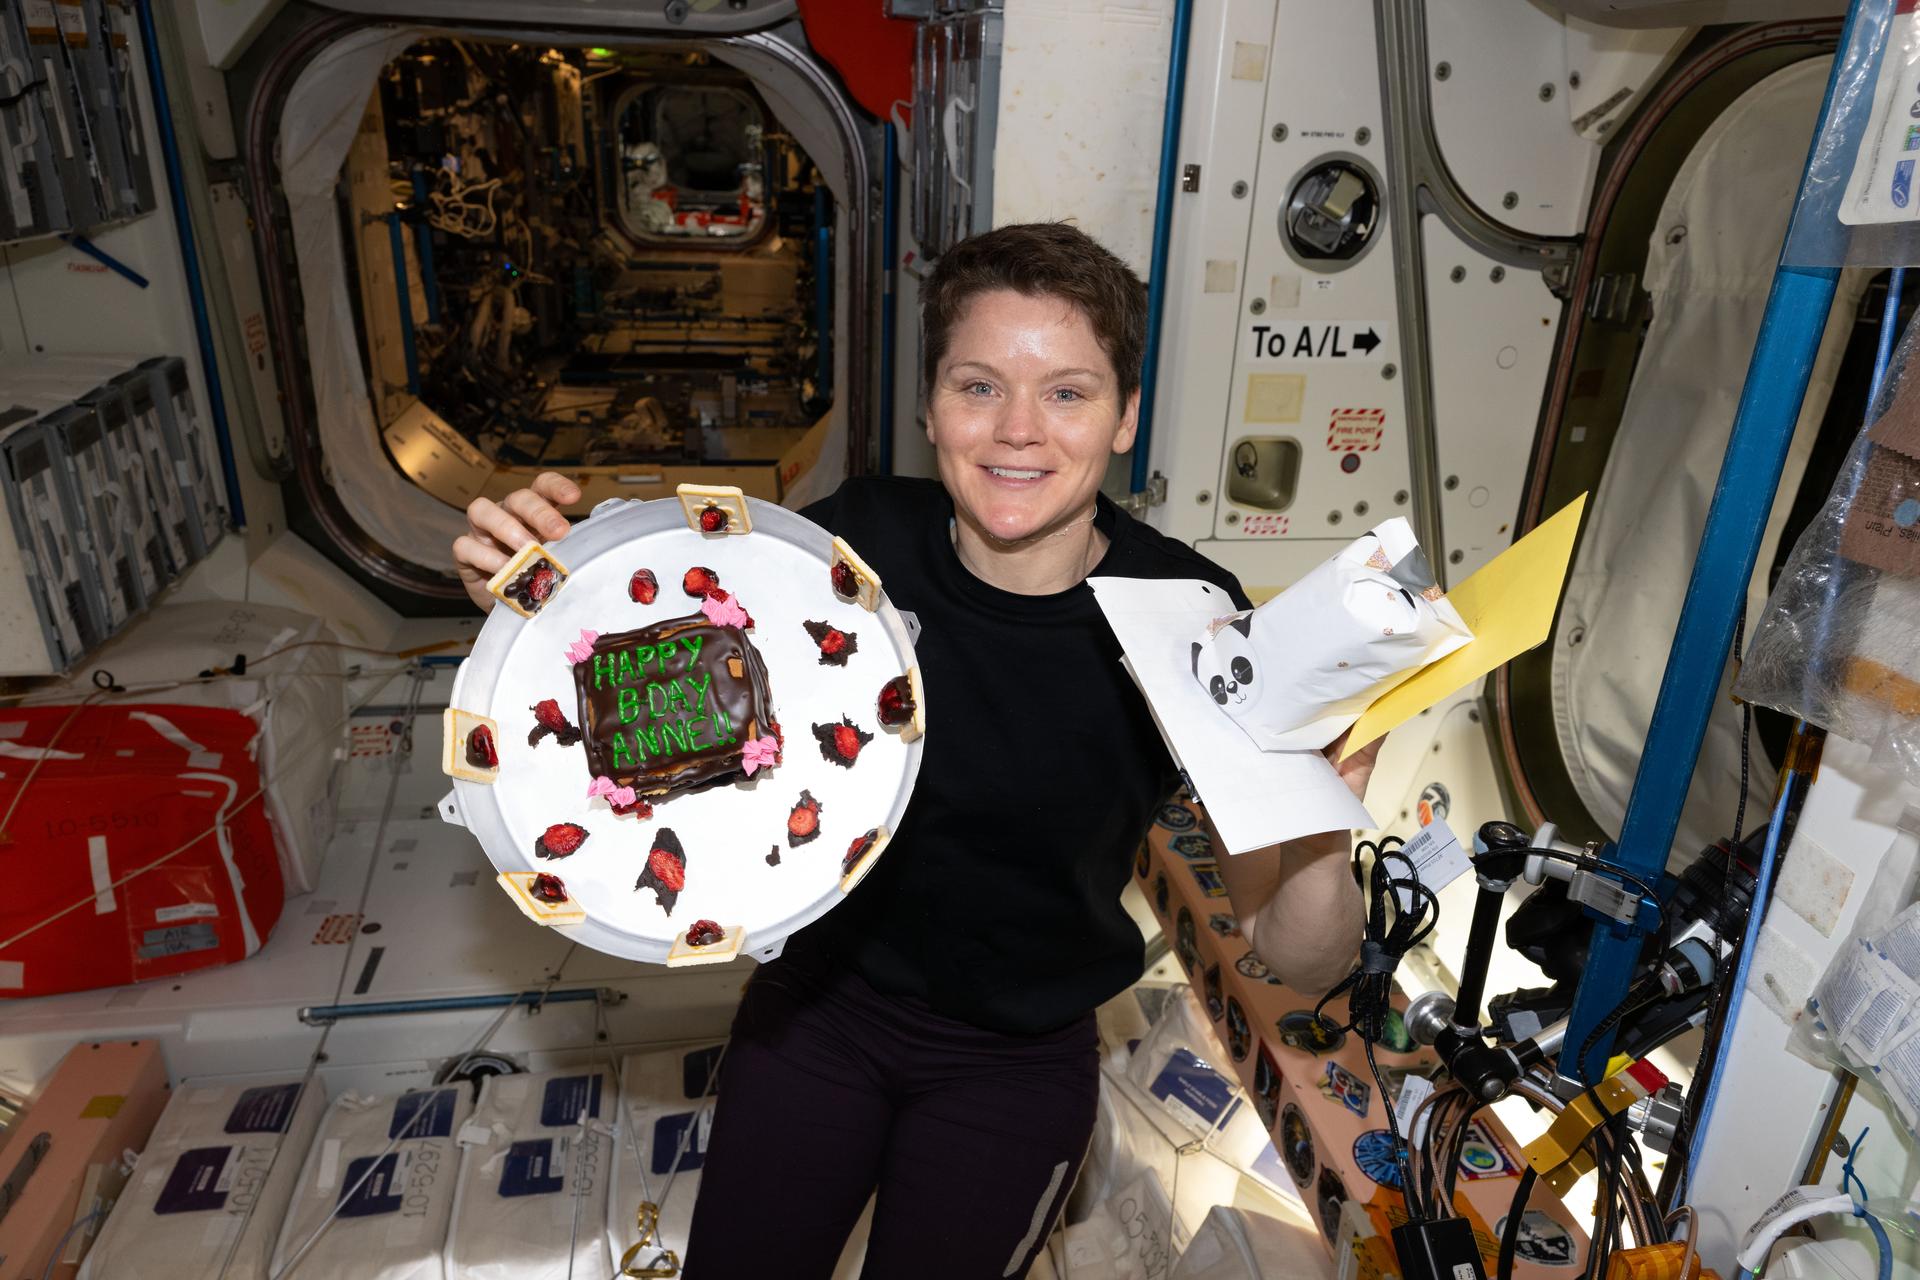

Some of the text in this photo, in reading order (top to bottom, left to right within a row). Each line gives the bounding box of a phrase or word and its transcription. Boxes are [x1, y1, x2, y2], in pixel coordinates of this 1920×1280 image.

[1251, 326, 1348, 358] To A/L
[1865, 519, 1894, 538] Plain
[594, 637, 702, 689] HAPPY
[613, 712, 736, 769] ANNE!!
[403, 1140, 443, 1219] 10-5297
